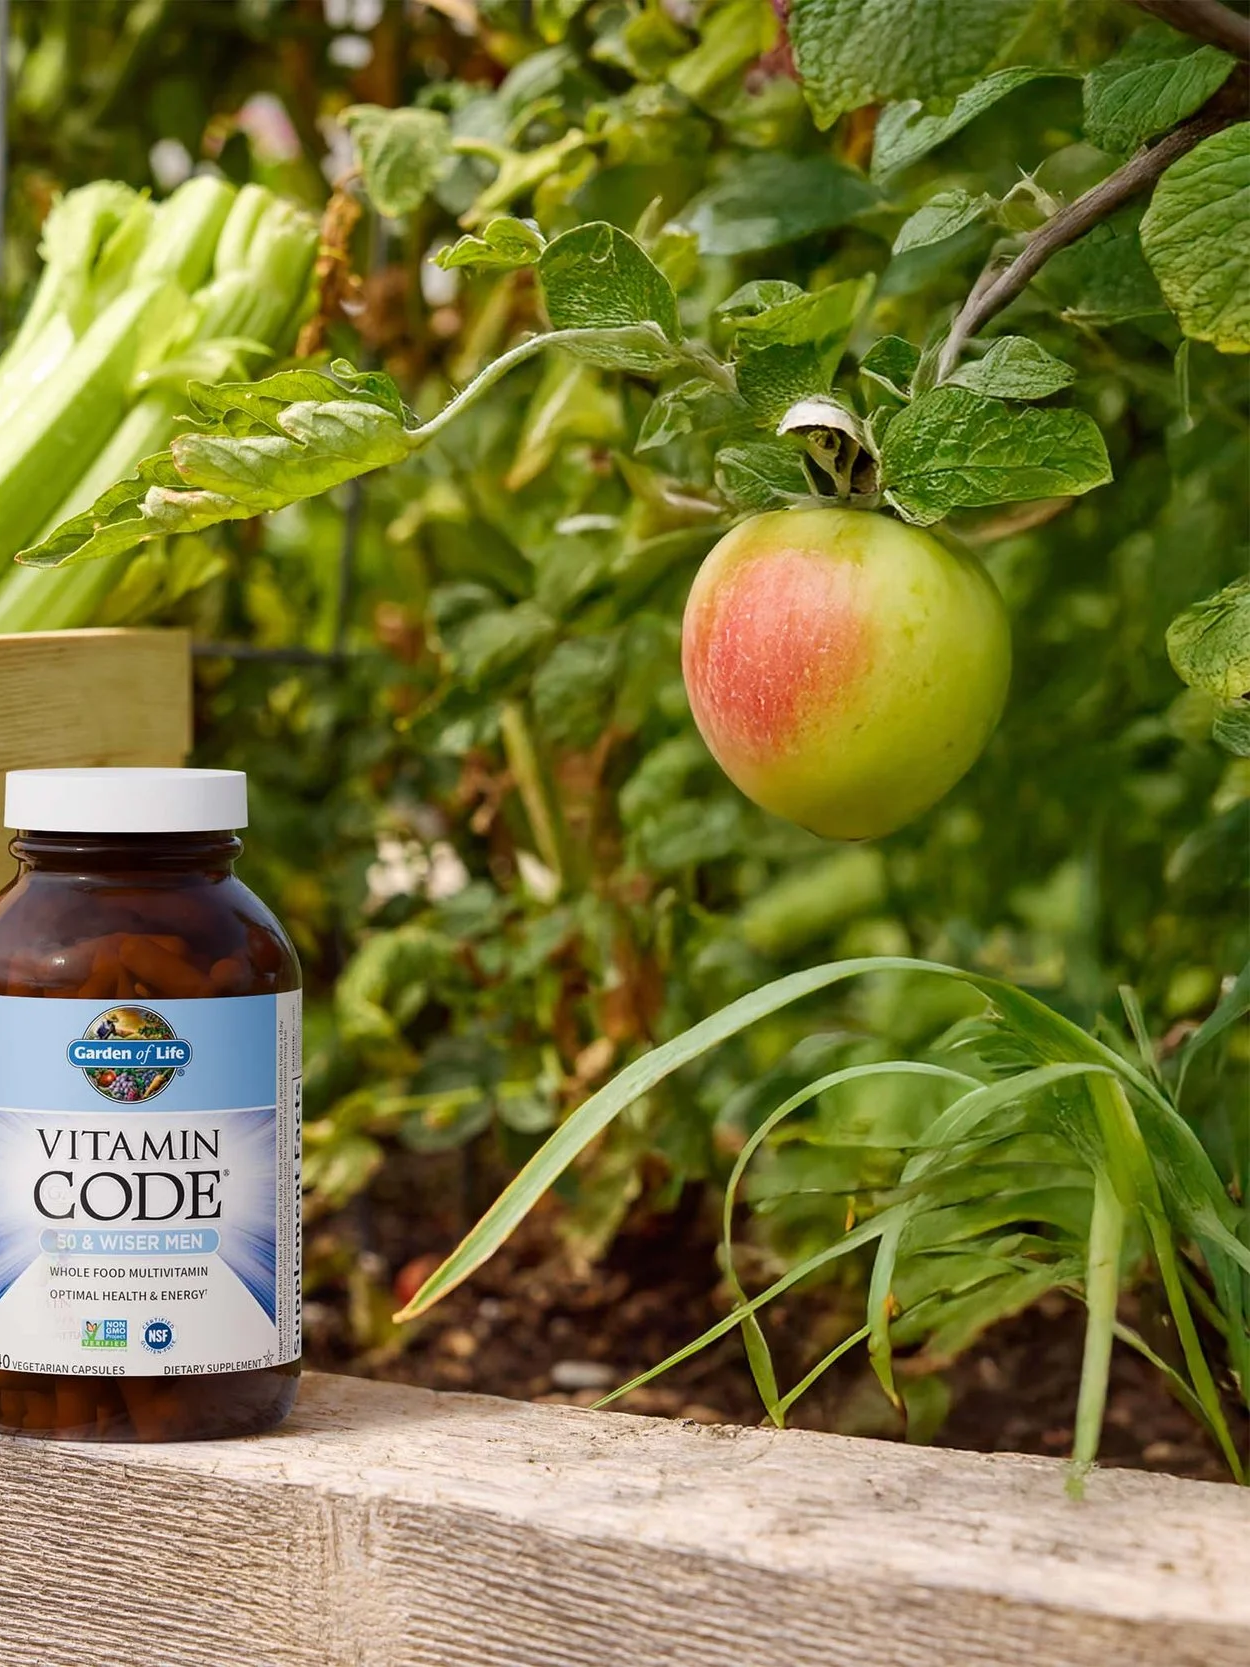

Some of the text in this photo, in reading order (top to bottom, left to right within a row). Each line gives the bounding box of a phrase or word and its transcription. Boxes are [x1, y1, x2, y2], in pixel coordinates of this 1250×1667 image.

[74, 1044, 185, 1065] Garden of Life
[36, 1129, 220, 1161] VITAMIN
[57, 1233, 203, 1250] 50 & WISER MEN
[50, 1266, 208, 1278] WHOLE FOOD MULTIVITAMIN
[50, 1289, 99, 1301] OPTIMAL
[102, 1291, 147, 1301] HEALTH
[150, 1291, 158, 1301] &
[105, 1327, 126, 1335] GMO
[148, 1329, 168, 1343] NSF
[12, 1361, 69, 1374] VEGETARIAN
[71, 1364, 126, 1375] CAPSULES
[164, 1358, 262, 1375] DIETARY SUPPLEMENT
